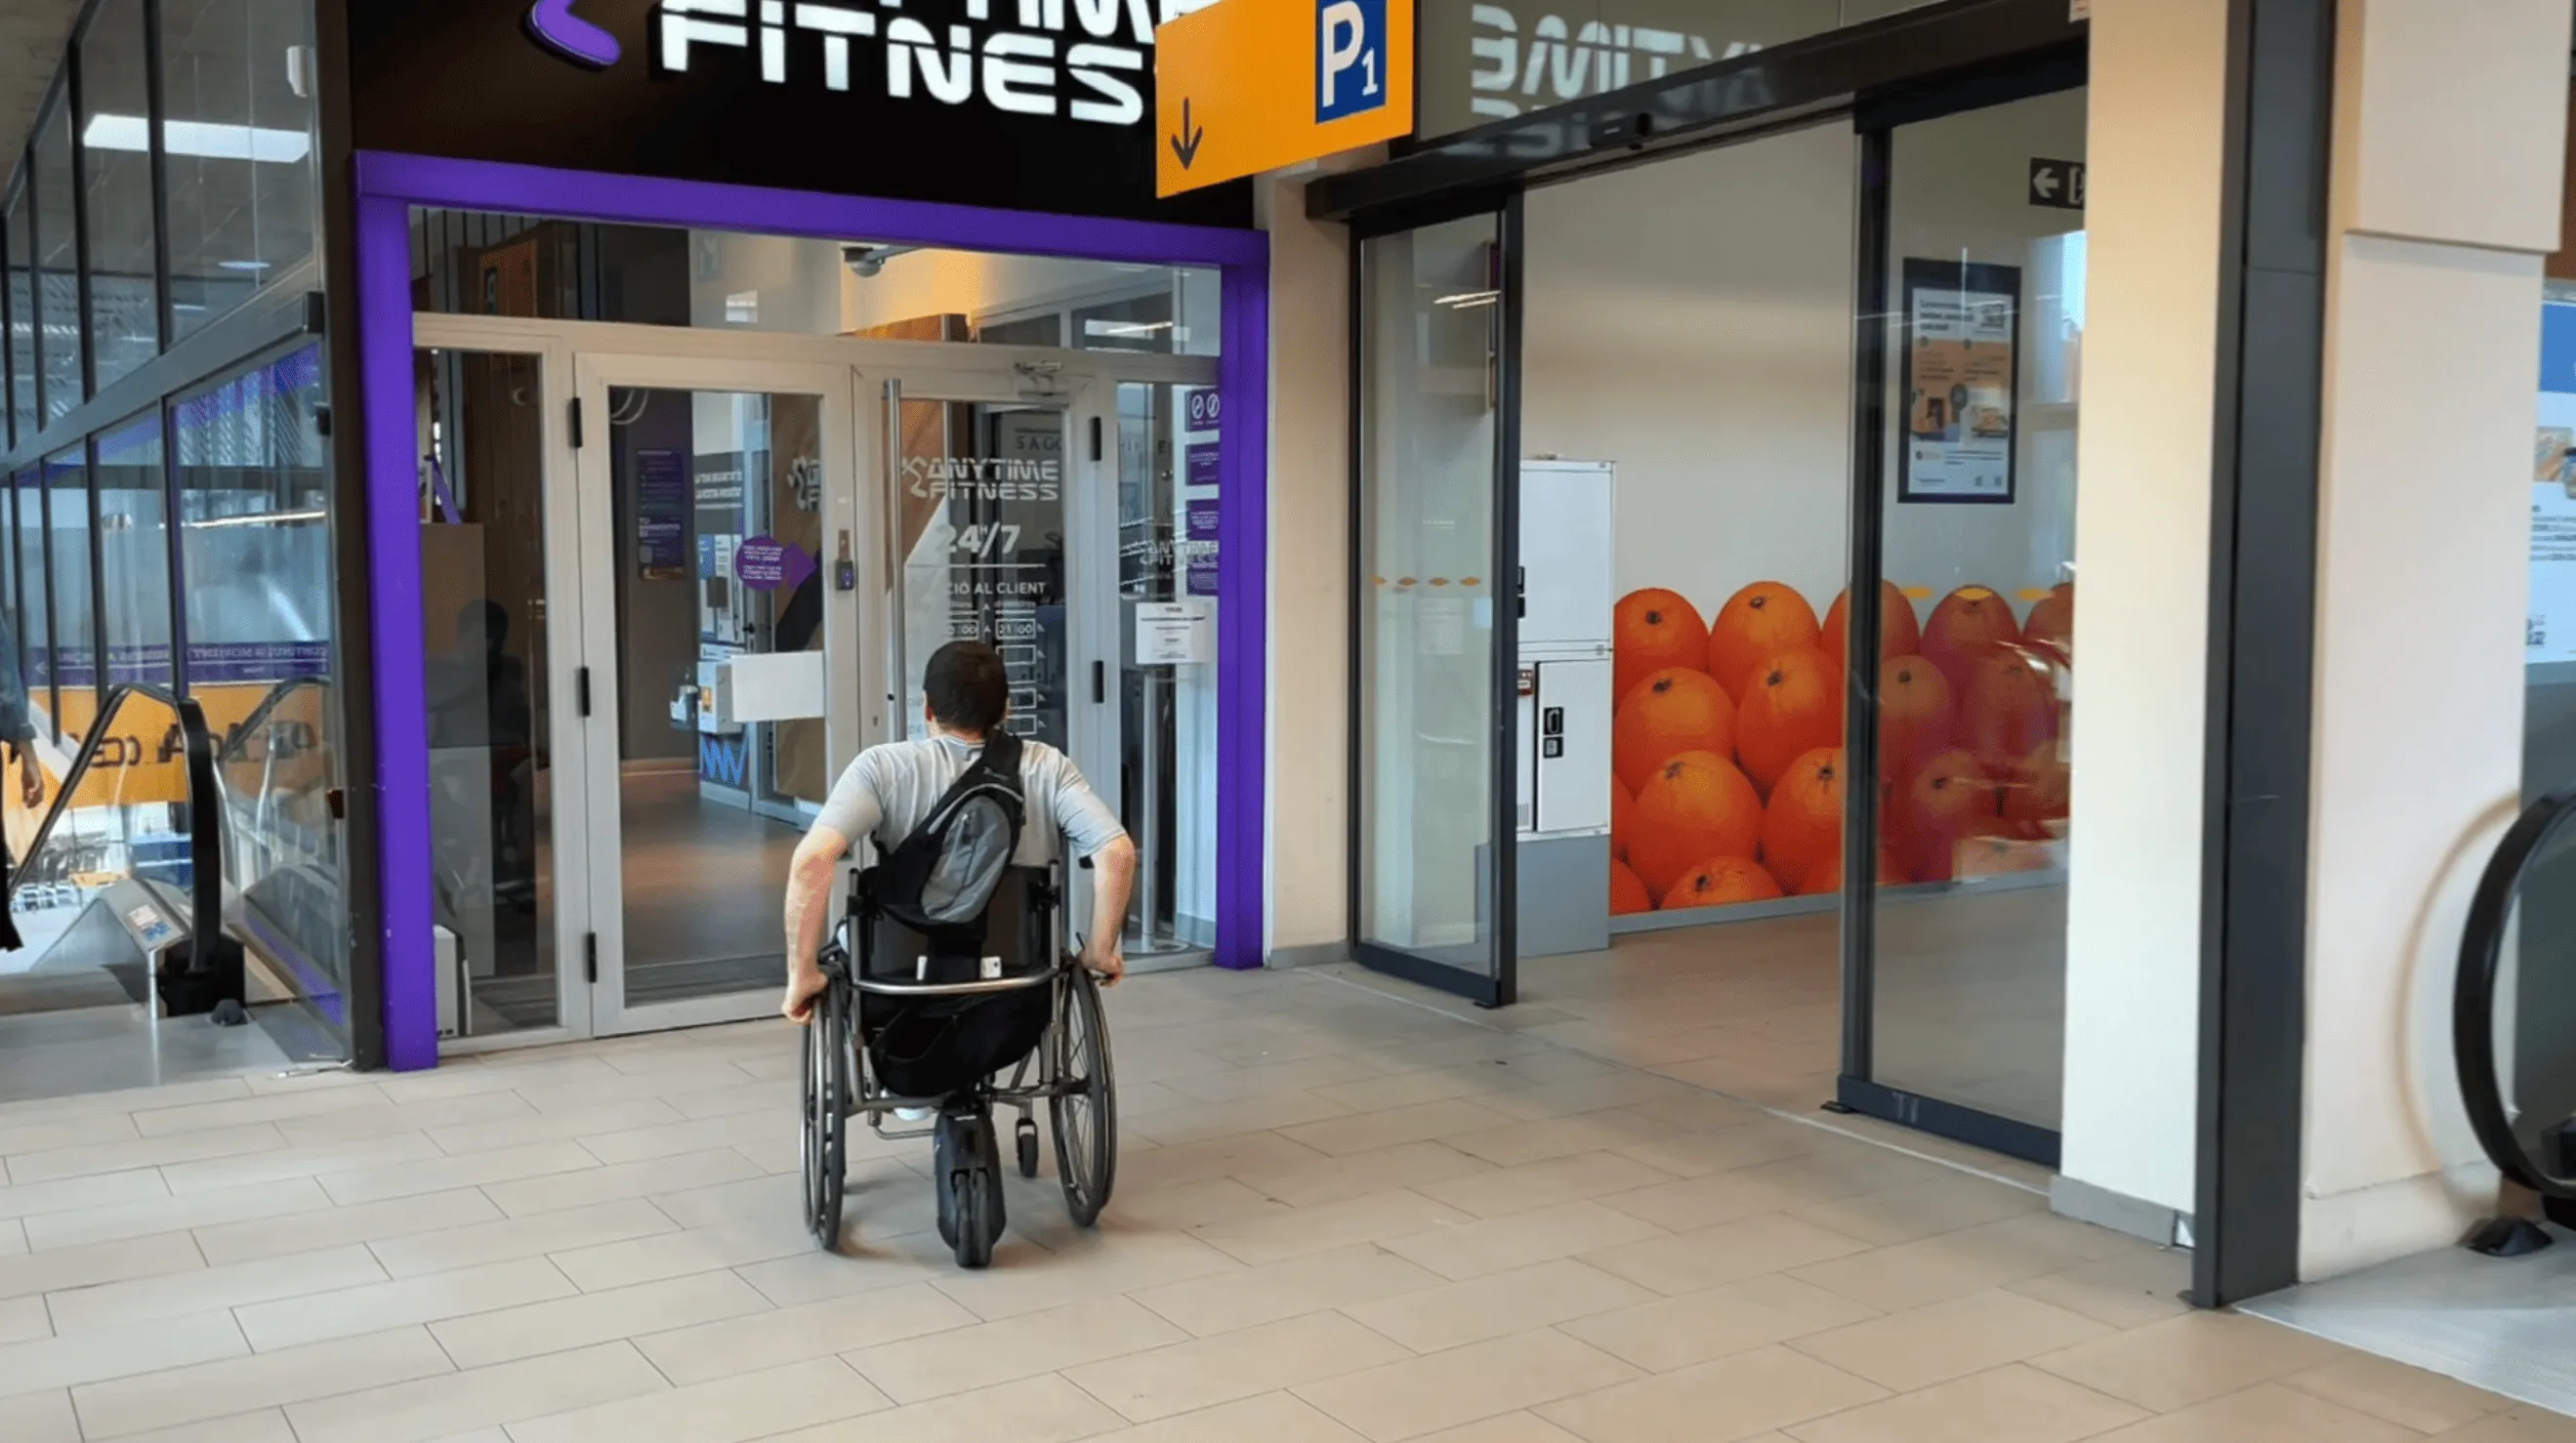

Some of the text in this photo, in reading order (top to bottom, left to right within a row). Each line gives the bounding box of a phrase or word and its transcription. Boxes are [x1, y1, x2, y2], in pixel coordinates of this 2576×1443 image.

[661, 0, 1144, 126] FITNES
[927, 457, 1059, 481] ANYTIME
[929, 481, 1059, 501] FITNESS
[974, 582, 993, 595] AL
[996, 581, 1046, 595] CLIENT
